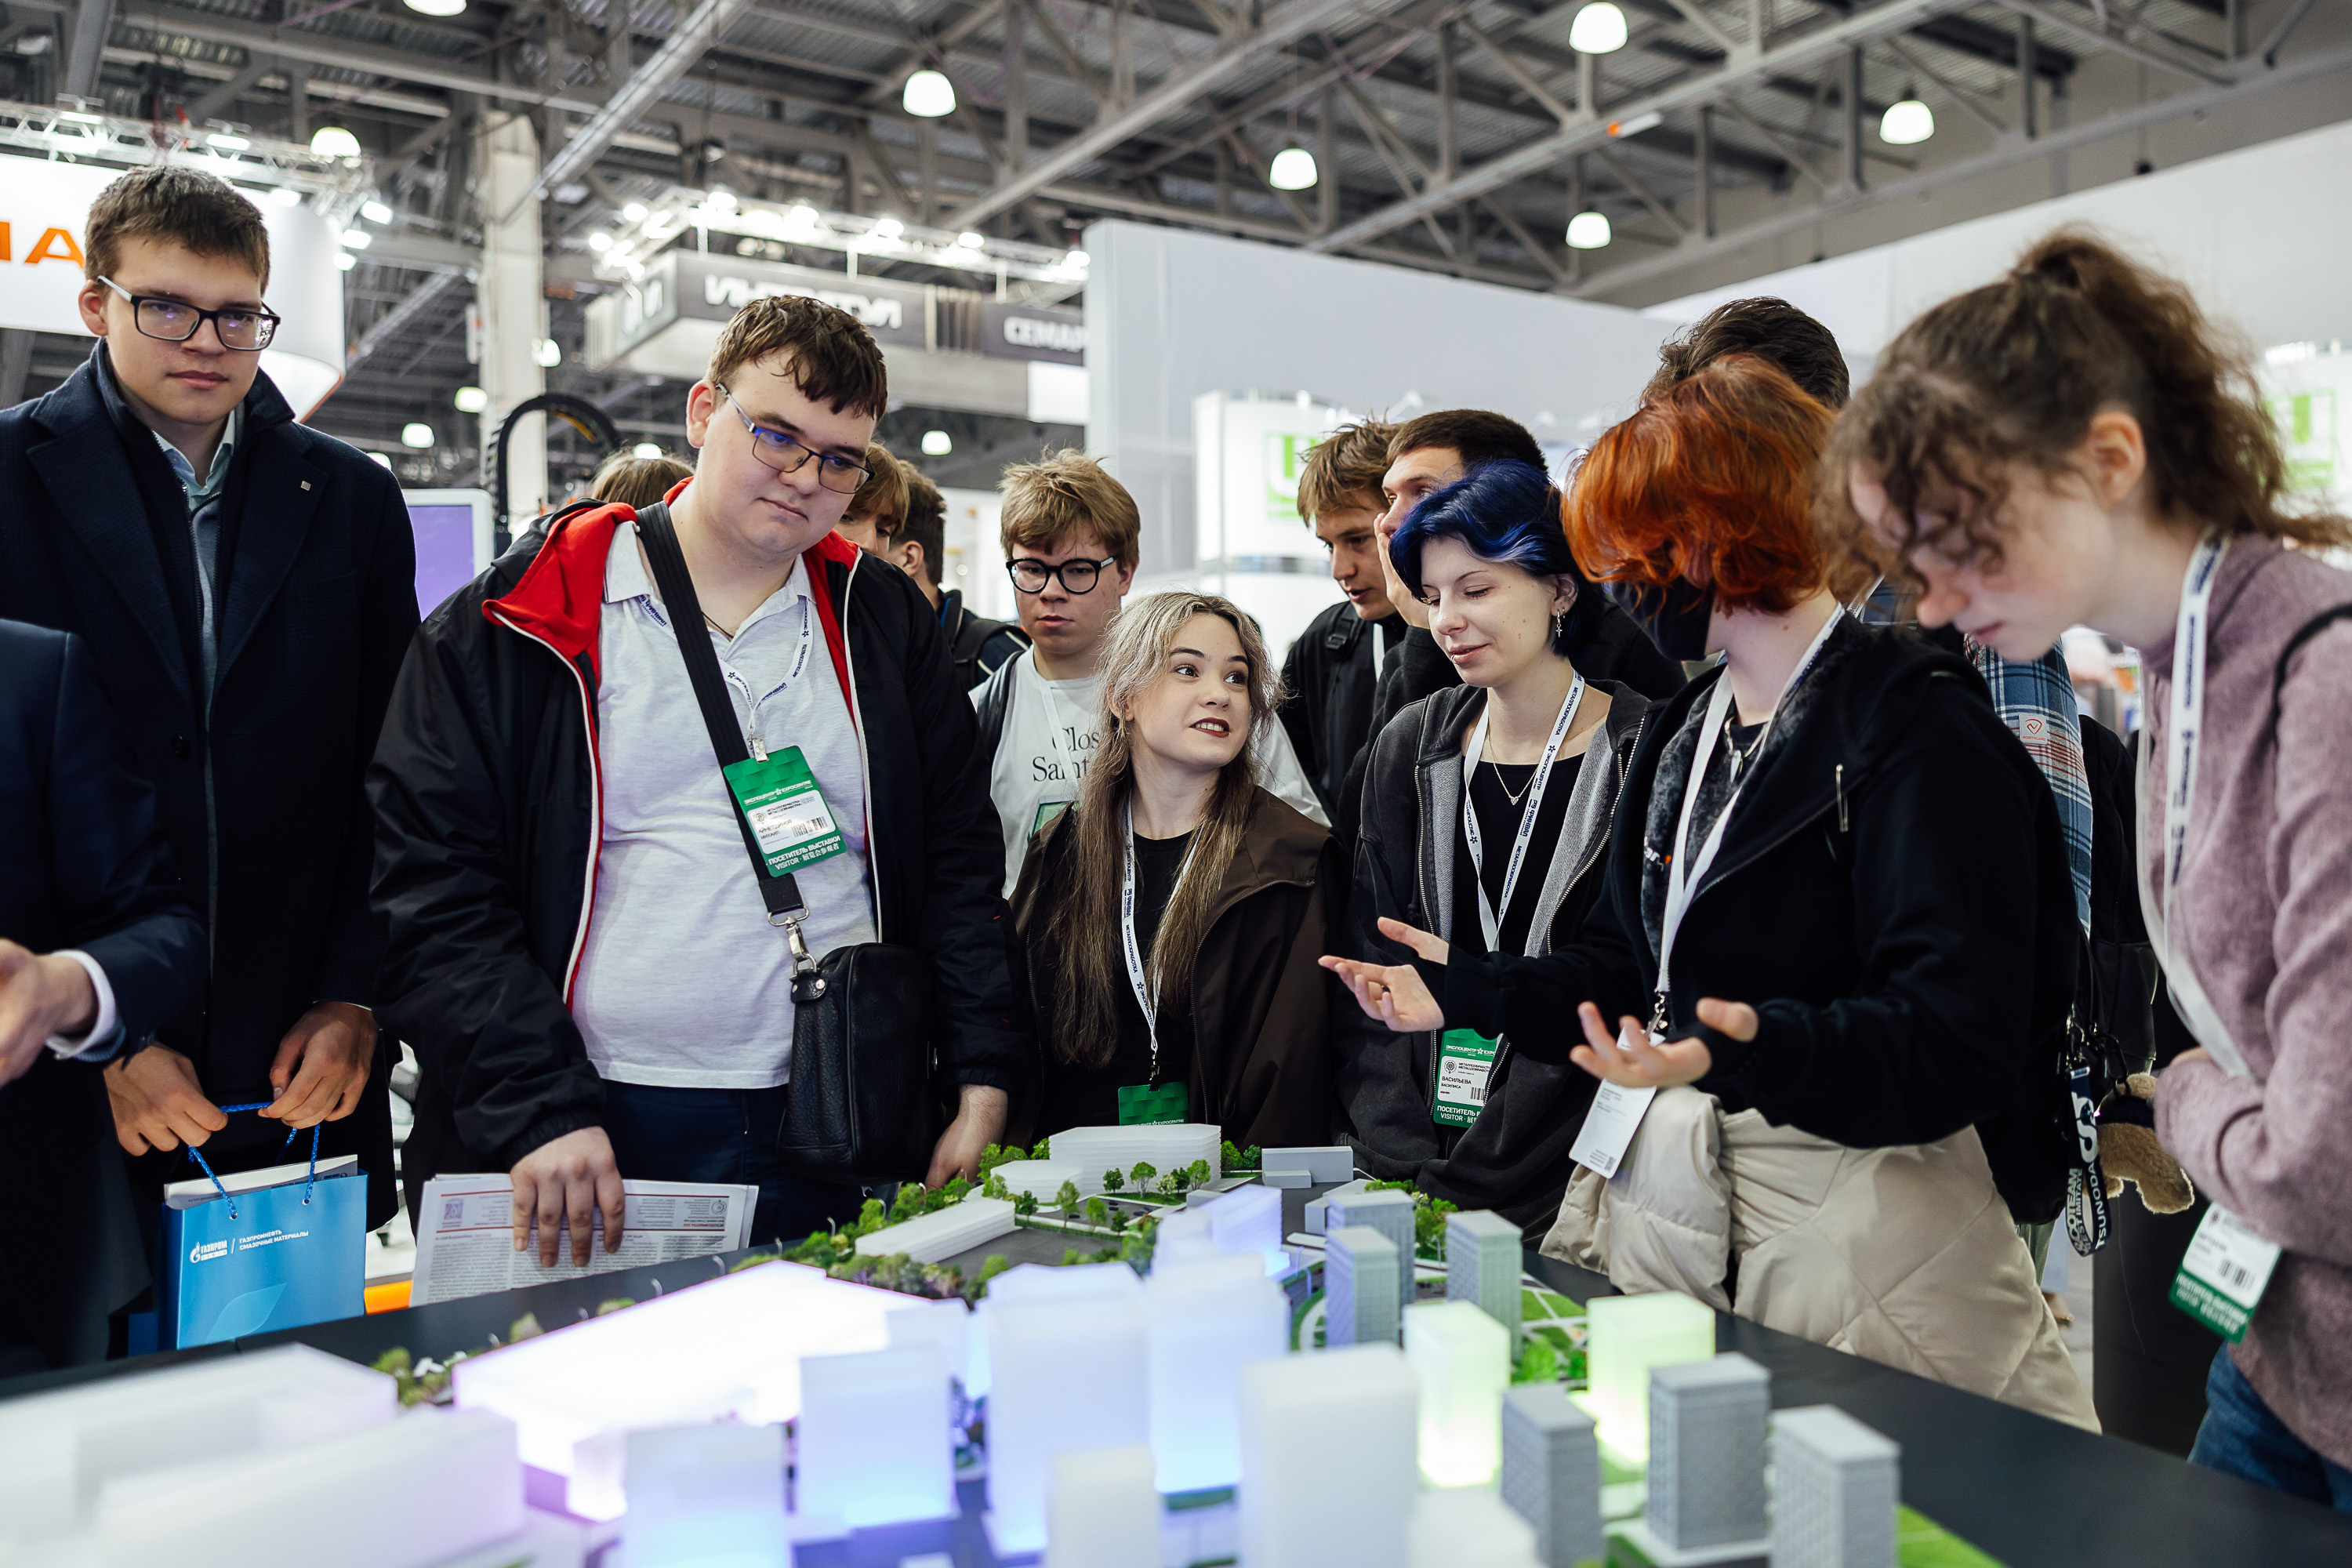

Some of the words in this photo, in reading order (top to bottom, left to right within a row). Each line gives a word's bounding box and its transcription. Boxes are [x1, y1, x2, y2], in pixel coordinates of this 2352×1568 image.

[768, 848, 808, 866] ПОСЕТИТЕЛЬ
[808, 835, 841, 851] ВЫСТАВКИ
[775, 857, 800, 870] VISITOR
[1446, 1044, 1477, 1053] ЭКСПОЦЕНТР
[1442, 1076, 1472, 1085] ВАСИЛЬЕВА
[1437, 1105, 1475, 1116] ПОСЕТИТЕЛЬ
[1440, 1112, 1463, 1121] VISITOR
[2089, 1162, 2107, 1250] TSUNODA
[239, 1229, 281, 1243] ГАЗПРОМНЕФТЬ
[239, 1238, 273, 1250] СМАЗОЧНЫЕ
[274, 1231, 309, 1243] МАТЕРИАЛЫ
[201, 1240, 227, 1254] ГАЗПРОМ
